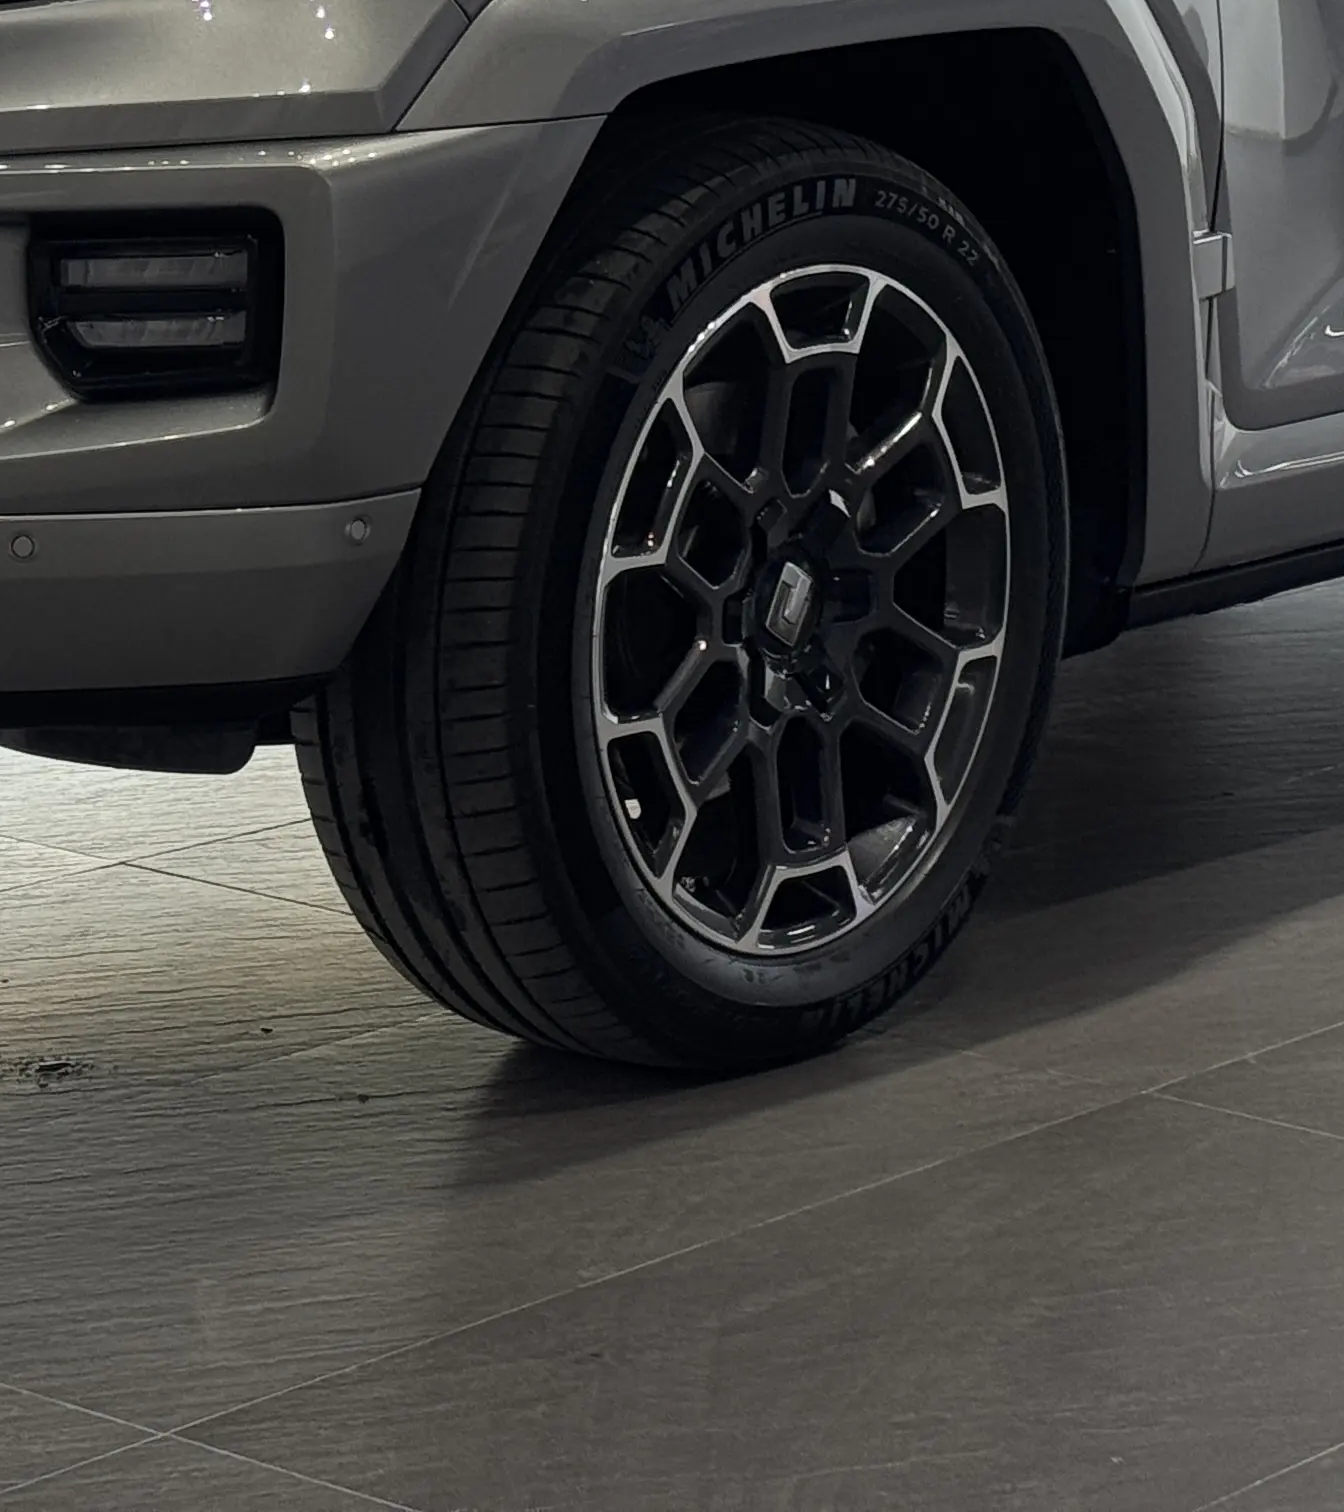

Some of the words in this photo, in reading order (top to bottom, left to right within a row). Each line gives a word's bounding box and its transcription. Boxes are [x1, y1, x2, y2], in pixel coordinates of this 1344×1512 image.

[666, 177, 857, 315] MICHELIN
[874, 189, 940, 231] 275/50
[941, 224, 957, 245] R
[956, 240, 980, 268] 22
